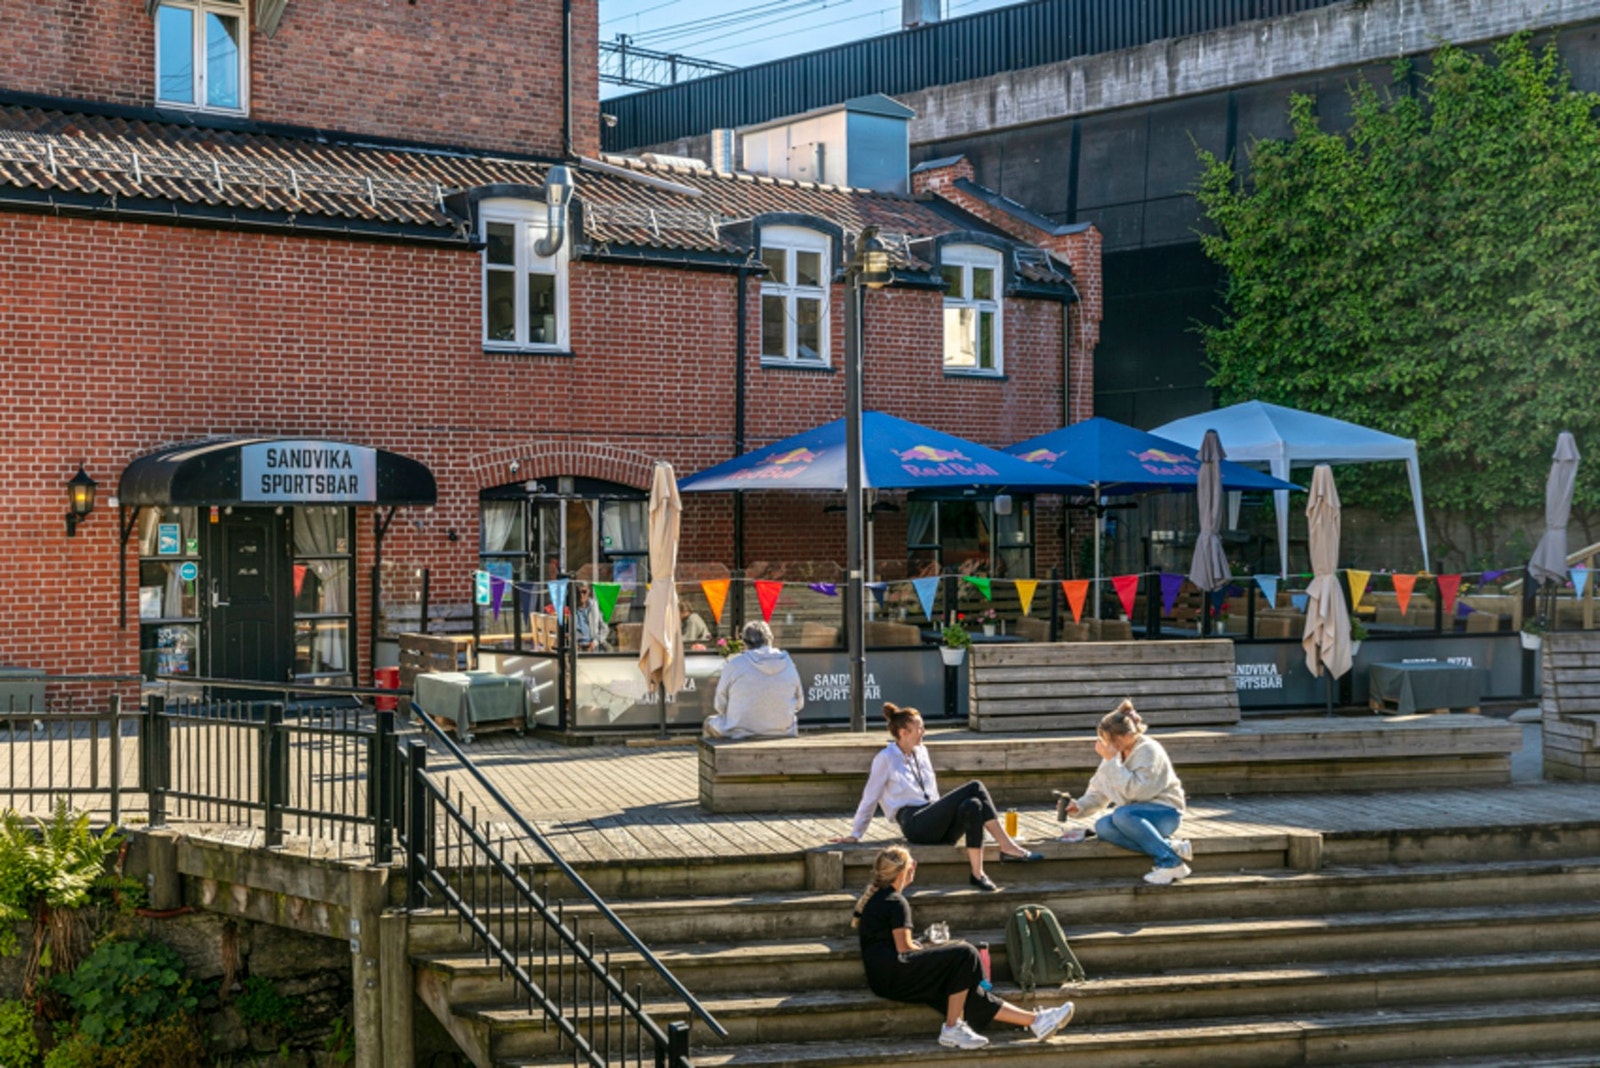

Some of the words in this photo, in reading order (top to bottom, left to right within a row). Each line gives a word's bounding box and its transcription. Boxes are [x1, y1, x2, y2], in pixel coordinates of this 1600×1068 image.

[267, 448, 352, 469] SANDVIKA
[261, 474, 359, 494] SPORTSBAR
[1236, 663, 1278, 675] NDVIKA
[814, 673, 876, 686] SANDA
[1235, 676, 1283, 689] RTSBAR
[808, 687, 881, 701] SPORTAR
